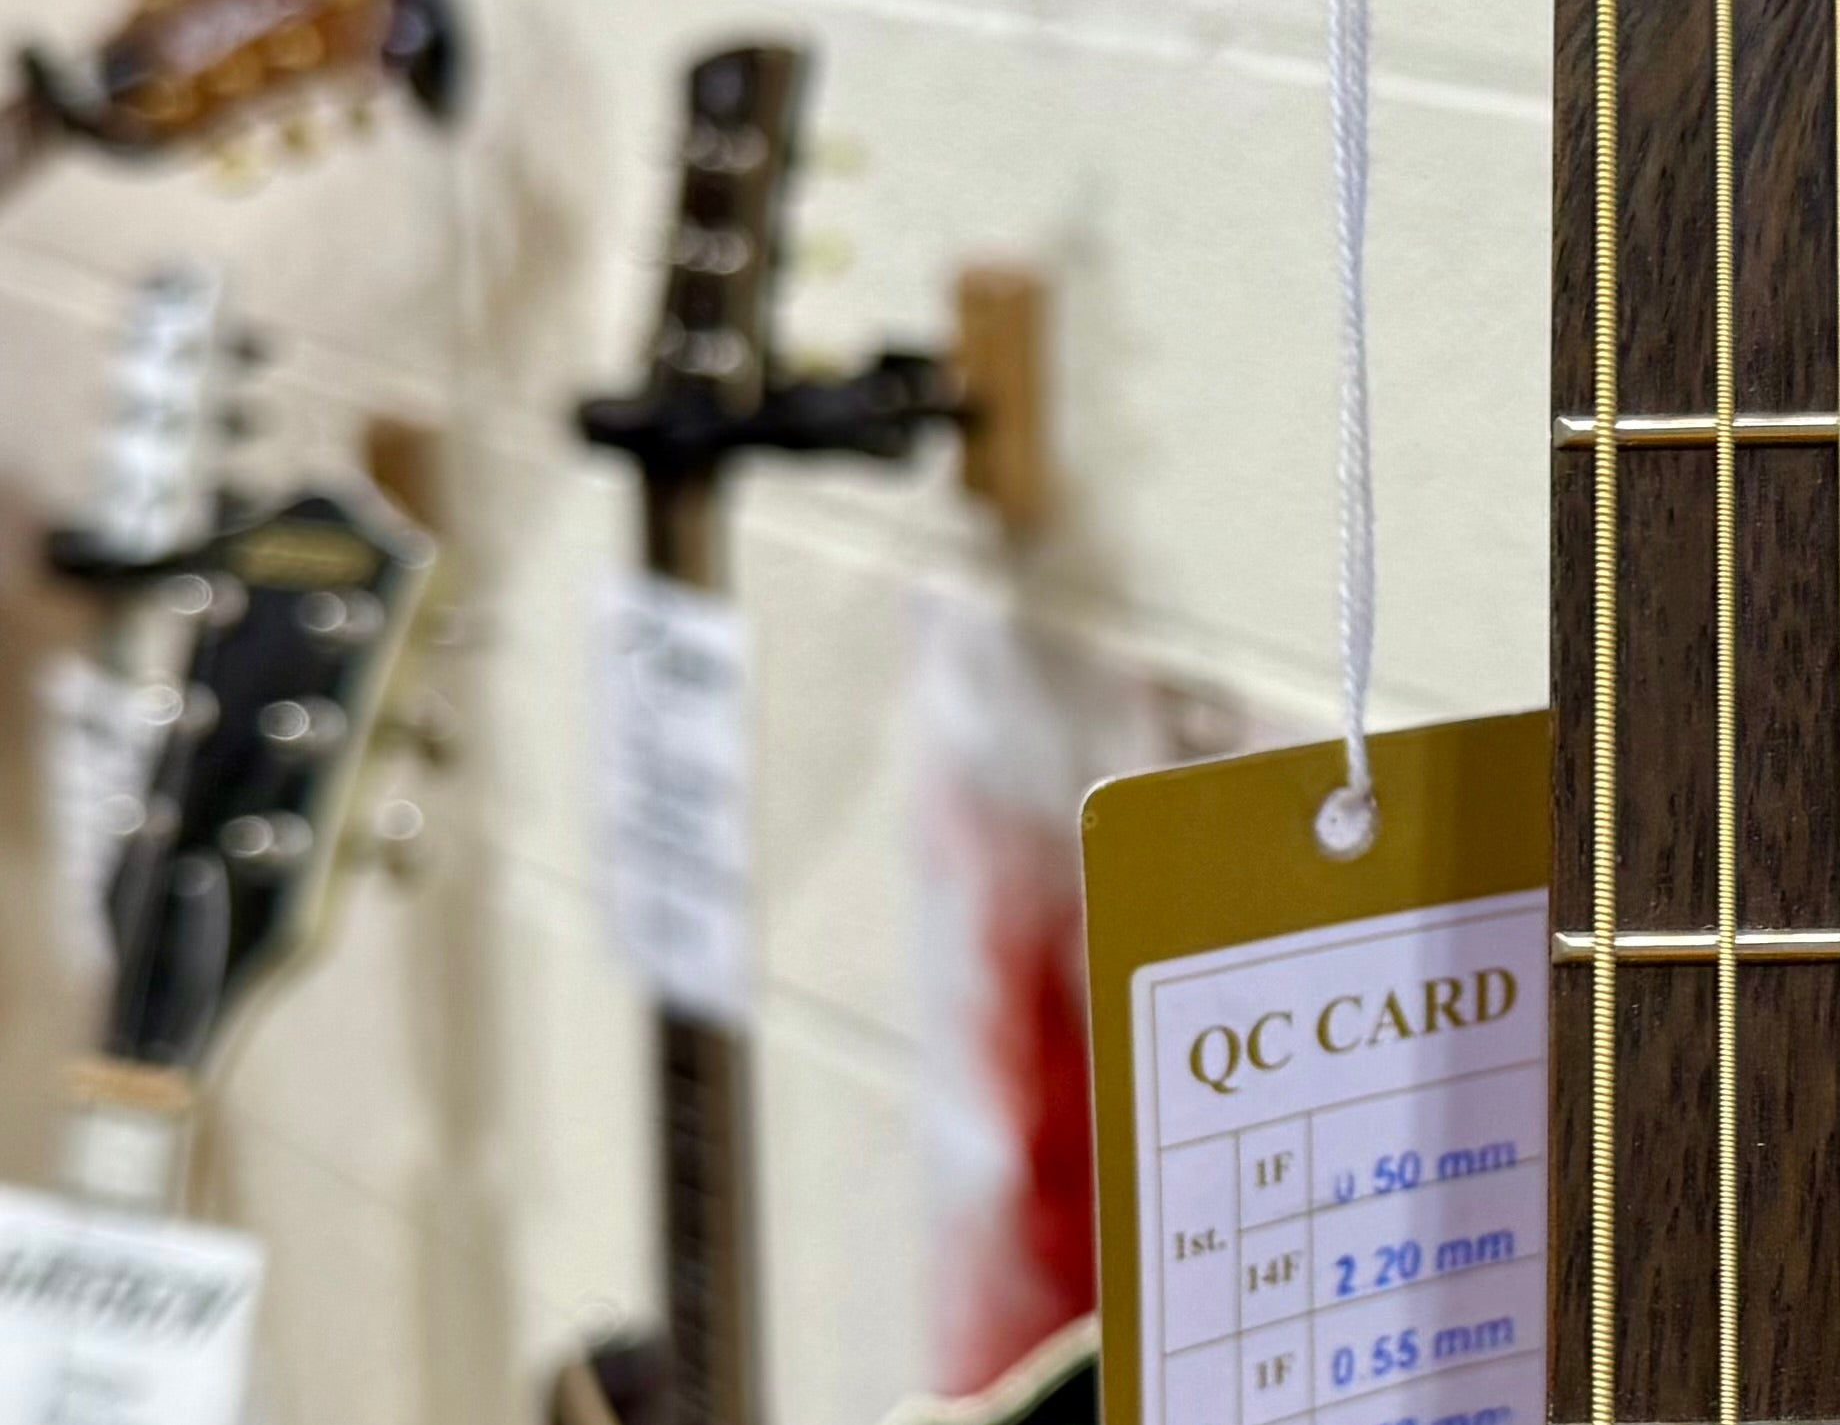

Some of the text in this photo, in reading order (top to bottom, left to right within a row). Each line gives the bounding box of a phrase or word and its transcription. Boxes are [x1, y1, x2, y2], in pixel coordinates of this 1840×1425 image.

[1189, 966, 1517, 1095] QC CARD
[1255, 1151, 1294, 1188] 1F
[1437, 1140, 1516, 1180] mm
[1248, 1250, 1302, 1292] 14F
[1435, 1229, 1515, 1271] mm
[1257, 1352, 1295, 1390] 1F
[1434, 1316, 1514, 1359] mm
